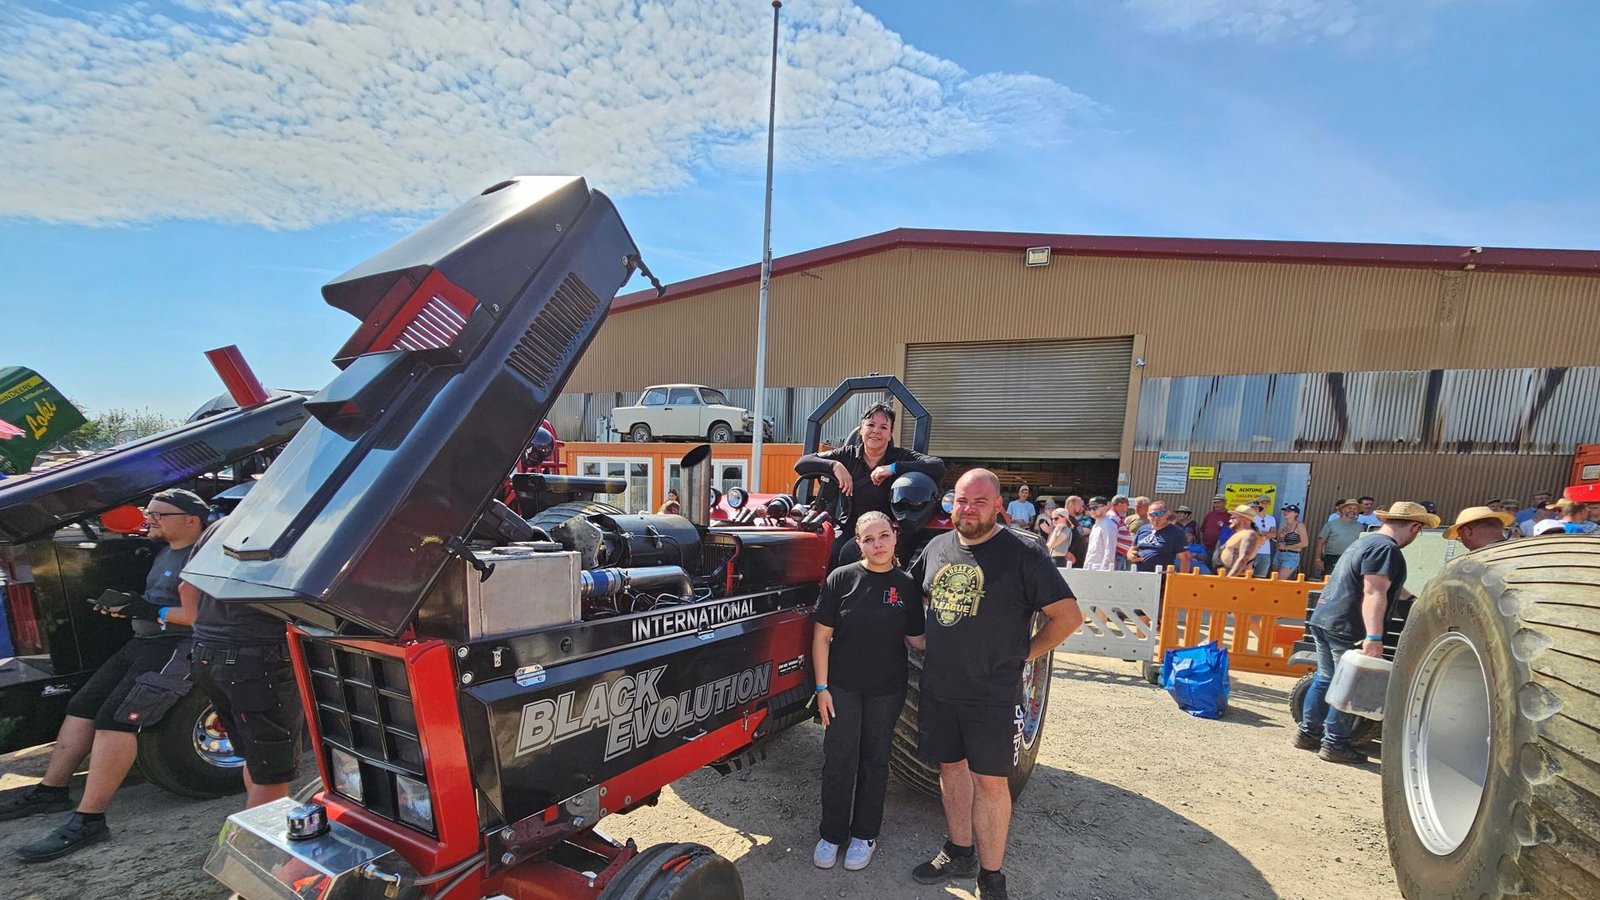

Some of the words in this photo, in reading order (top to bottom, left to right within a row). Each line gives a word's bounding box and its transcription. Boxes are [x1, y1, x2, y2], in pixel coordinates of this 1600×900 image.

[944, 565, 967, 577] LUCAS
[967, 568, 976, 580] OIL
[631, 599, 757, 642] INTERNATIONAL
[934, 601, 971, 613] LEAGUE
[515, 664, 668, 758] BLACK
[603, 662, 773, 762] EVOLUTION
